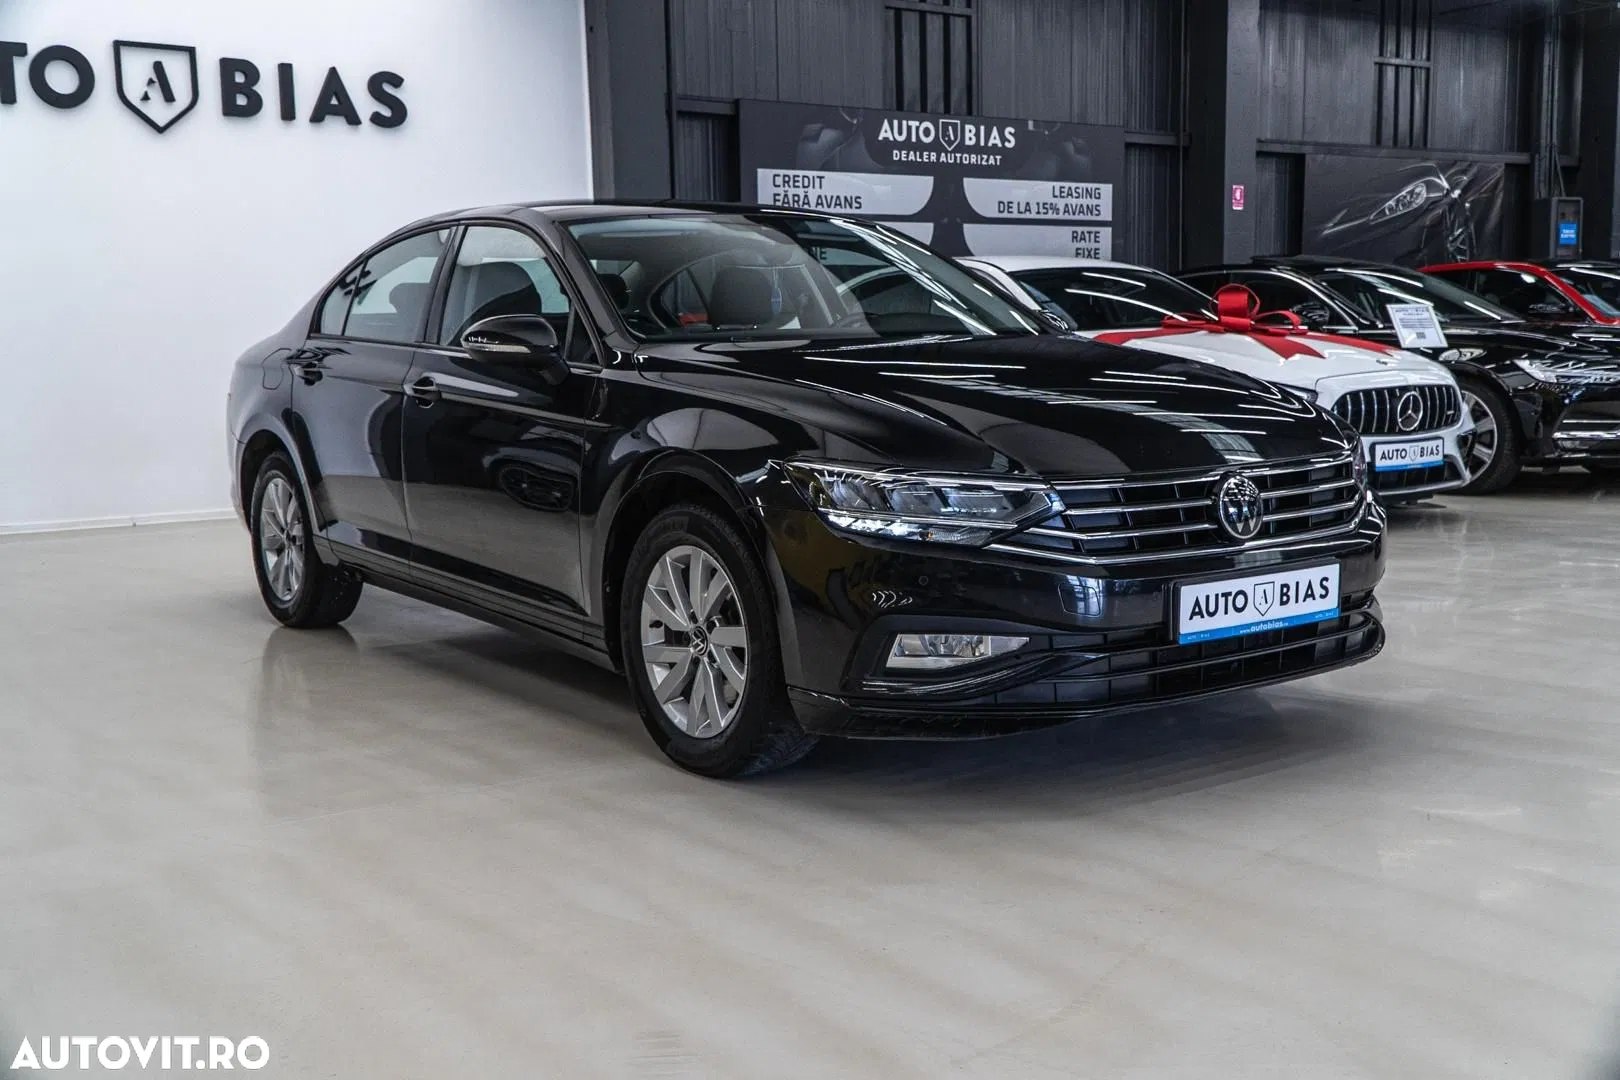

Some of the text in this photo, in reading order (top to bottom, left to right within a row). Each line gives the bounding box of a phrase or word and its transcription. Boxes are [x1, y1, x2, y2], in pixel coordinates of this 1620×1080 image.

[219, 56, 409, 129] BIAS
[878, 118, 936, 144] AUTO
[964, 123, 1016, 149] BIAS
[892, 150, 1002, 166] DEALER AUTORIZAT
[772, 173, 826, 190] CREDIT
[1051, 185, 1102, 200] LEASING
[815, 194, 863, 210] AVANS
[997, 200, 1102, 217] DE LA 15% AVANS
[1071, 230, 1101, 244] RATE
[1074, 247, 1101, 261] FIXE
[1380, 444, 1440, 461] AUTO BIAS
[1189, 589, 1249, 621] AUTO
[1279, 576, 1330, 607] BIAS
